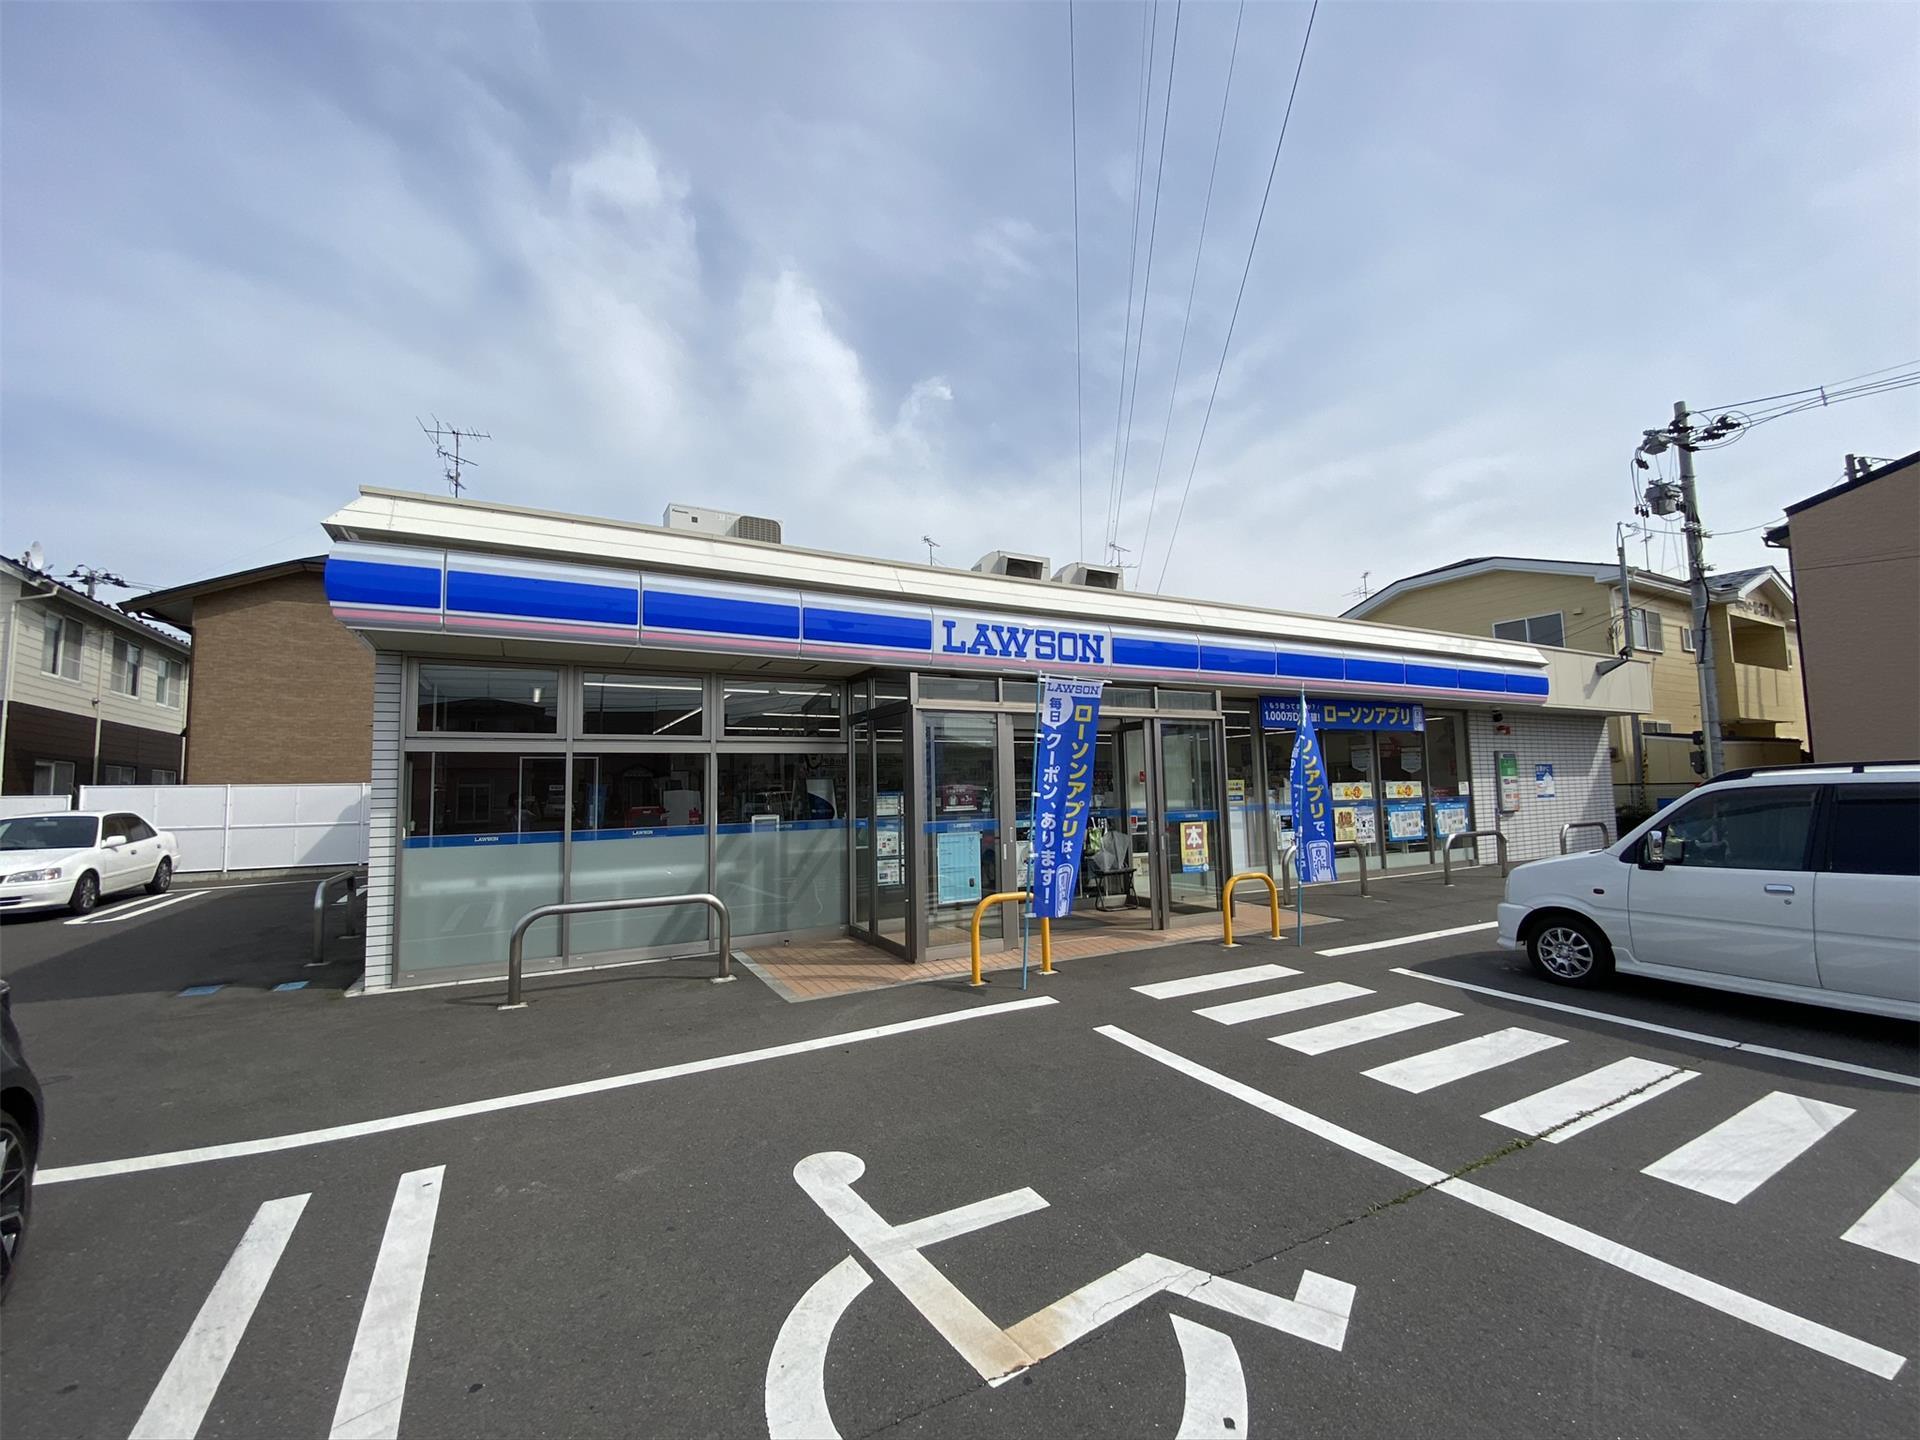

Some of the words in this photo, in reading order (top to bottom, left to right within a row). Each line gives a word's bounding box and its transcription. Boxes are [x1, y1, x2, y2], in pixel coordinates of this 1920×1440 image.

[942, 620, 1105, 664] LAWSON
[1046, 682, 1101, 695] LAWSON
[1323, 705, 1411, 725] ローソンアプリ
[1186, 825, 1202, 848] 本
